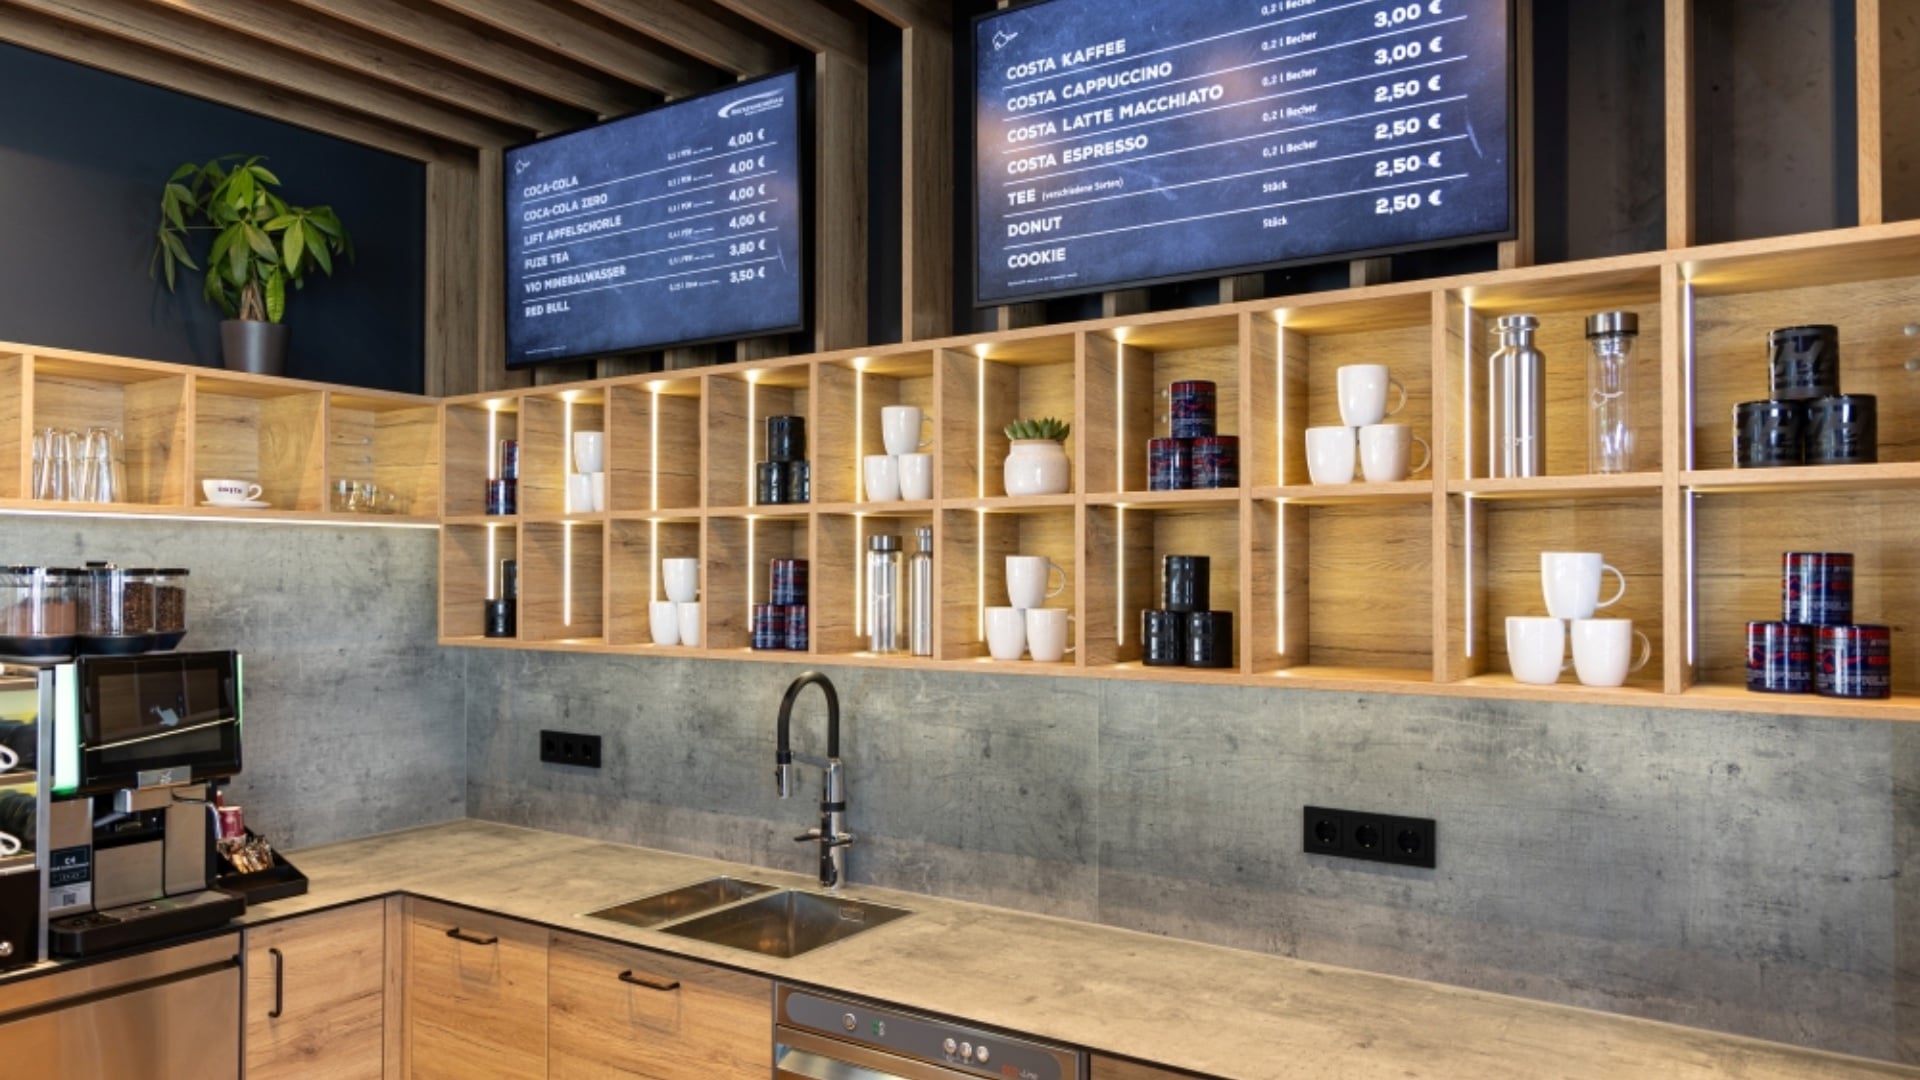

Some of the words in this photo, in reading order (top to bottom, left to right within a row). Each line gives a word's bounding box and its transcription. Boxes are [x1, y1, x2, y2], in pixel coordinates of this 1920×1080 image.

[1006, 89, 1057, 112] COSTA
[1062, 61, 1173, 99] CAPPUCCINO
[1261, 40, 1278, 51] 0,2
[1286, 31, 1317, 46] Becher
[1374, 4, 1421, 28] 3,00
[1428, 0, 1442, 15] €
[1006, 57, 1057, 80] COSTA
[1061, 38, 1126, 67] KAFFEE
[1007, 121, 1057, 143] COSTA
[1063, 108, 1115, 132] LATTE
[1118, 84, 1224, 120] MACCHIATO
[1261, 76, 1278, 87] 0,2
[1286, 68, 1317, 82] Becher
[1374, 41, 1421, 65] 3,00
[1429, 36, 1442, 53] €
[1007, 153, 1057, 175] COSTA
[1063, 134, 1149, 165] ESPRESSO
[1262, 111, 1278, 122] 0,2
[1286, 104, 1317, 117] Becher
[1374, 80, 1420, 102] 2,50
[1428, 75, 1441, 91] €
[1007, 188, 1036, 206] TEE
[1042, 184, 1093, 202] (verschiedene
[1094, 176, 1124, 191] Sorten)
[1262, 147, 1278, 158] 0,2
[1286, 140, 1318, 153] Becher
[1375, 118, 1420, 140] 2,50
[1428, 113, 1441, 129] €
[523, 175, 579, 198] COCA-COLA
[727, 131, 754, 148] 4,00
[757, 127, 765, 141] €
[523, 200, 579, 222] COCA-COLA
[581, 193, 608, 209] ZERO
[728, 158, 754, 176] 4,00
[757, 154, 766, 168] €
[1007, 216, 1063, 237] DONUT
[1262, 180, 1288, 192] Stück
[1375, 155, 1420, 177] 2,50
[1428, 152, 1441, 167] €
[523, 230, 544, 246] LIFT
[546, 214, 622, 241] APFELSCHORLE
[728, 186, 755, 203] 4,00
[757, 182, 766, 196] €
[524, 254, 547, 270] FUZE
[549, 251, 570, 264] TEA
[728, 214, 755, 230] 4,00
[758, 210, 766, 224] €
[1007, 248, 1067, 269] COOKIE
[1262, 217, 1288, 229] Stück
[1375, 193, 1421, 214] 2,50
[1428, 189, 1441, 206] €
[525, 279, 543, 293] VIO
[544, 264, 627, 289] MINERALWASSER
[728, 241, 755, 257] 3,80
[758, 238, 766, 251] €
[525, 304, 544, 318] RED
[546, 300, 570, 314] BULL
[728, 269, 755, 284] 3,50
[758, 266, 766, 279] €
